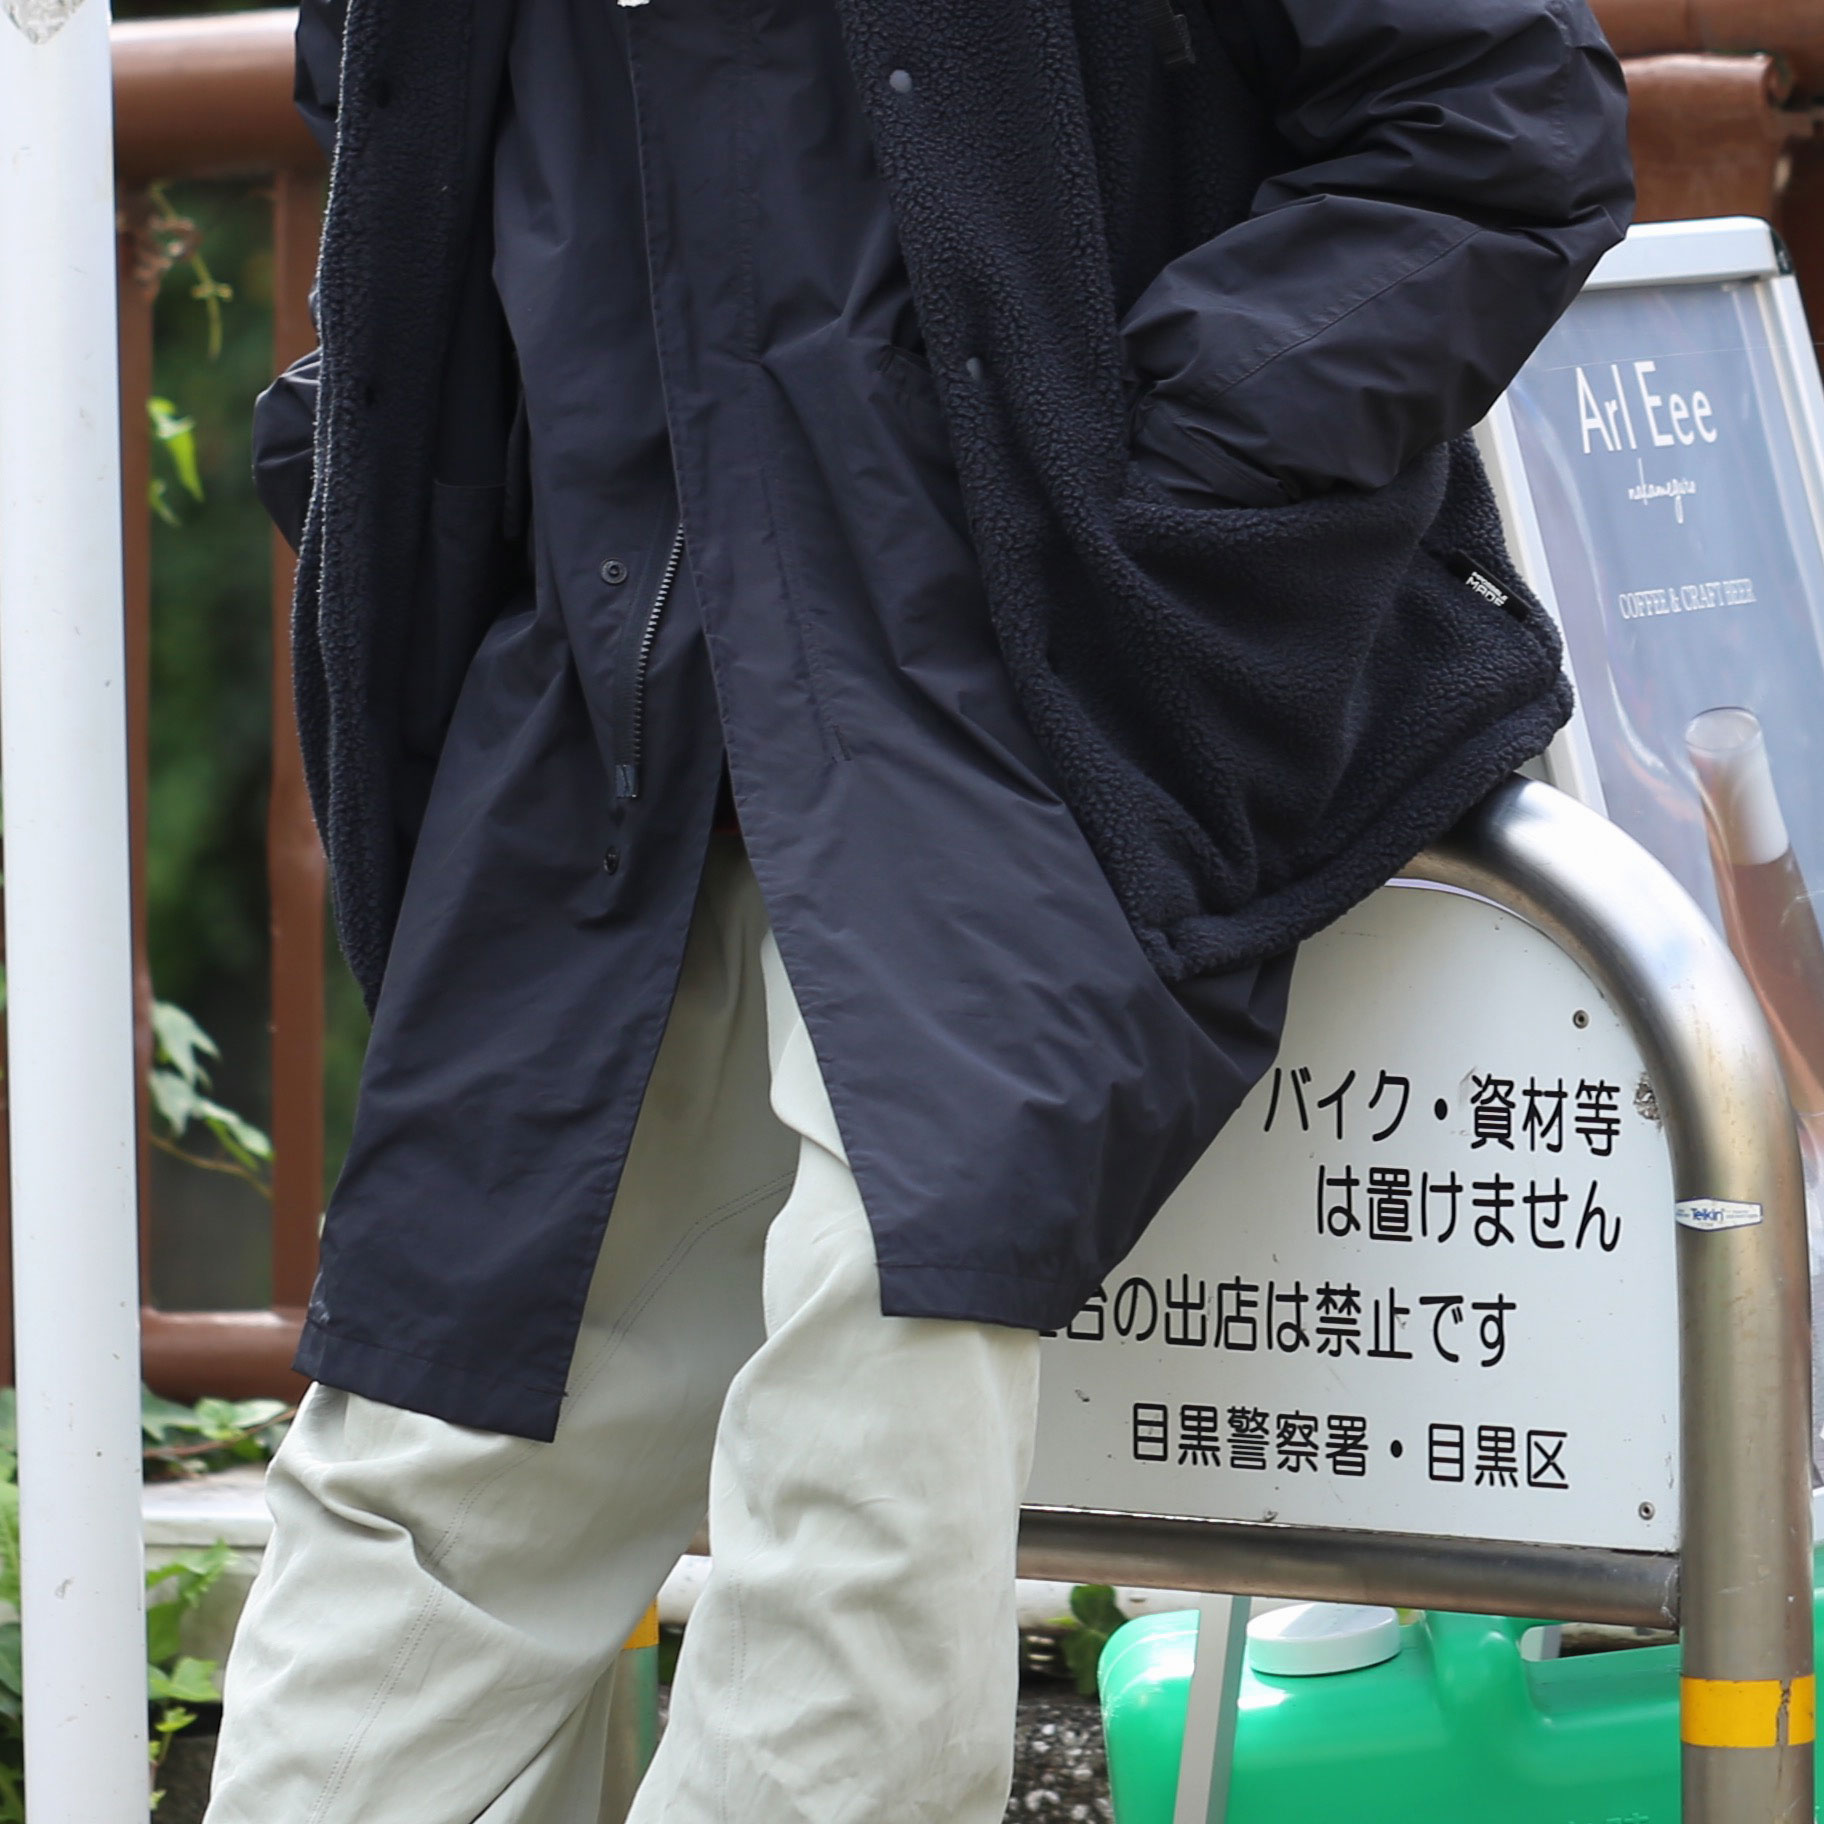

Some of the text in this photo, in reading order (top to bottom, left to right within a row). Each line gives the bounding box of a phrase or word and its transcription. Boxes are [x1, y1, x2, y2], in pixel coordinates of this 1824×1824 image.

[1634, 360, 1718, 447] Eee
[1619, 589, 1670, 619] COFFEE
[1667, 588, 1682, 613] &
[1680, 581, 1725, 611] CRAFT
[1263, 1066, 1622, 1157] バイク・資材等
[1317, 1164, 1622, 1253] は置けません
[1039, 1273, 1518, 1368] 台の出店は禁止です
[1132, 1402, 1570, 1491] 目黒警察署・目黒区
